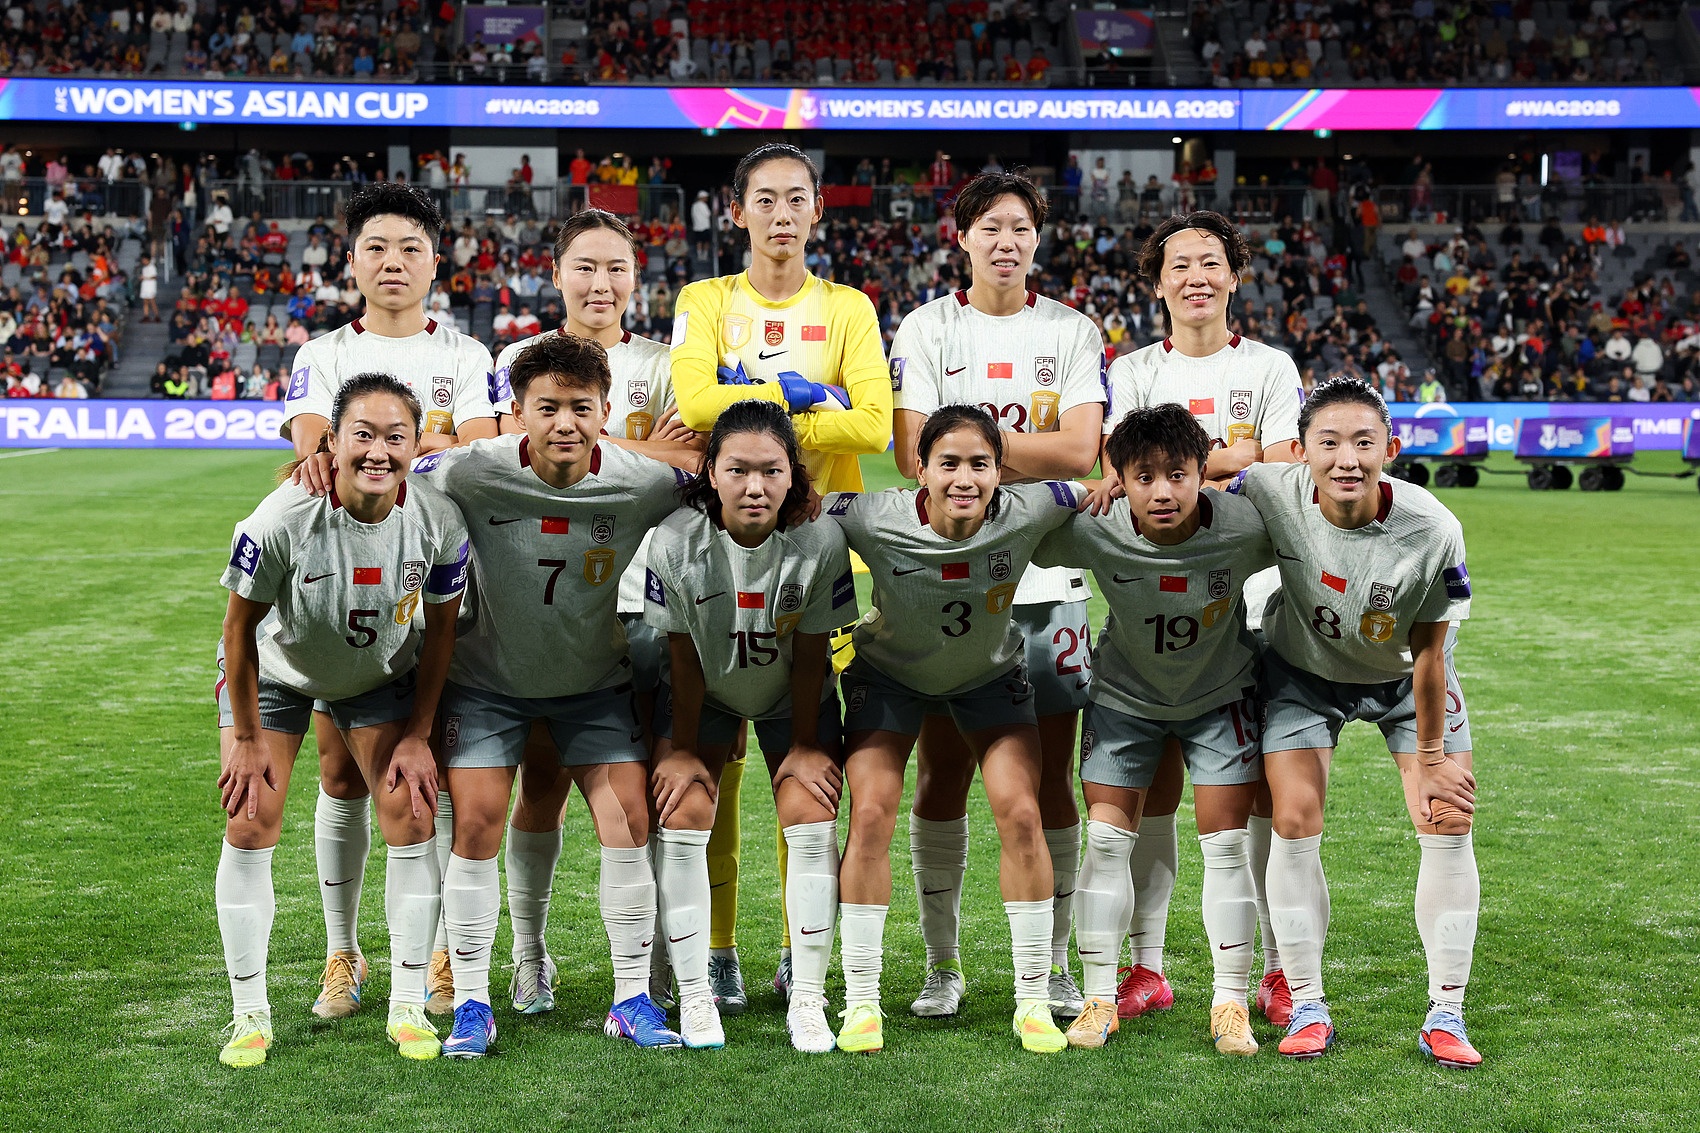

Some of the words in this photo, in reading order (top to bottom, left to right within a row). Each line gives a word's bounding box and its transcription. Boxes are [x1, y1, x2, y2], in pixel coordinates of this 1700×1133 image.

[69, 87, 235, 116] WOMEN'S
[241, 90, 349, 118] ASIAN
[355, 91, 428, 119] CUP
[485, 98, 600, 115] #WAC2026
[829, 99, 925, 118] WOMEN'S
[927, 100, 991, 118] ASIAN
[993, 100, 1038, 118] CUP
[1038, 100, 1172, 119] AUSTRALIA
[1174, 100, 1235, 118] 2026
[1505, 99, 1620, 117] #WAC2026
[434, 378, 452, 386] CFA
[0, 407, 156, 439] RALIA
[164, 408, 285, 440] 2026
[990, 553, 1009, 561] CFA
[538, 559, 567, 605] 7
[1373, 583, 1393, 593] CFA
[345, 609, 379, 648] 5
[941, 600, 972, 638] 3
[1144, 614, 1199, 654] 19
[1312, 605, 1342, 639] 8
[728, 630, 779, 668] 15
[1053, 624, 1093, 676] 23
